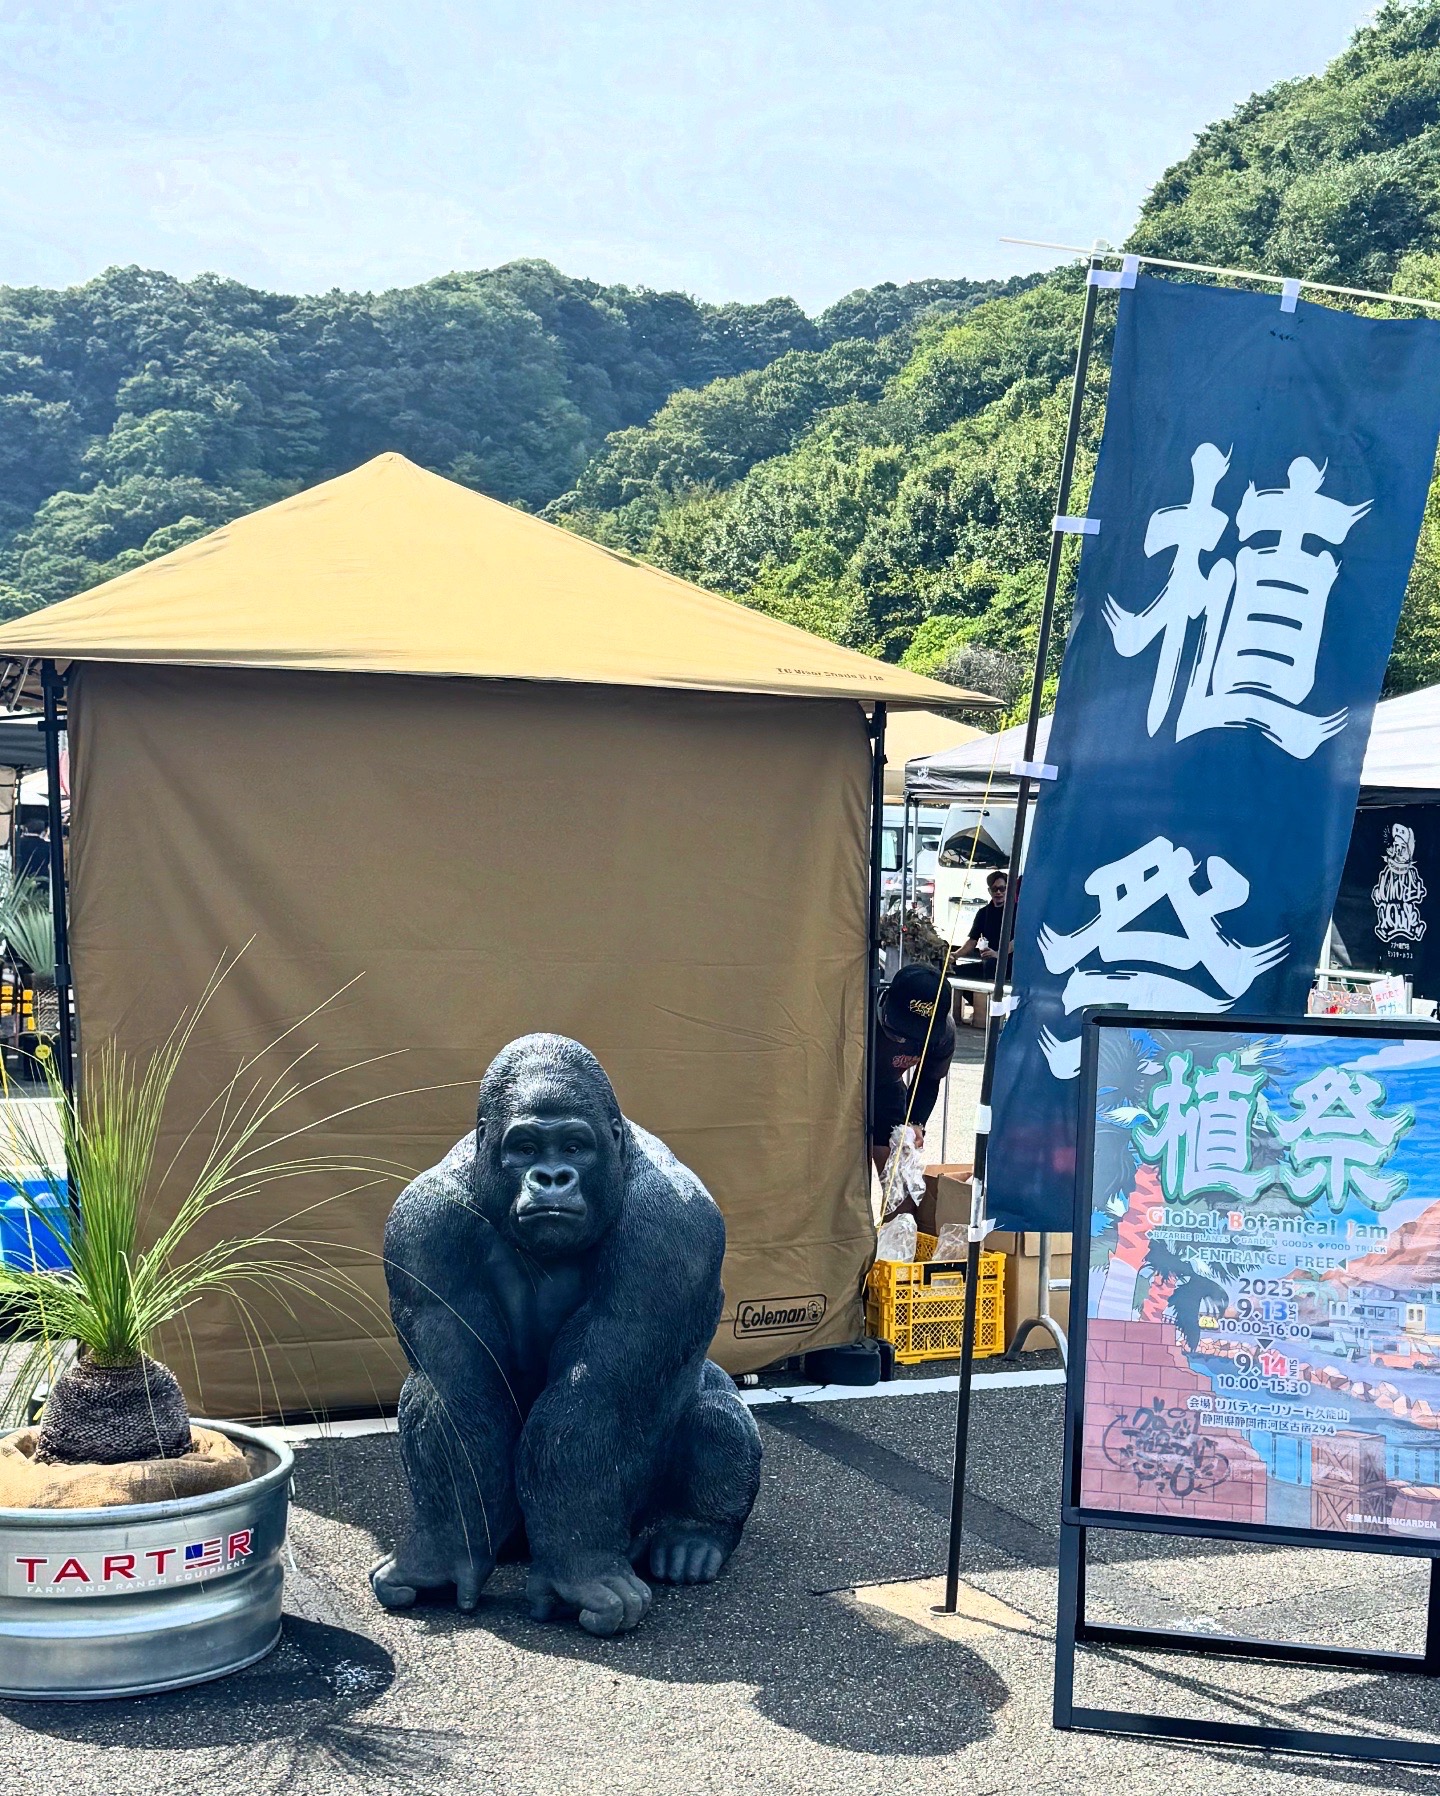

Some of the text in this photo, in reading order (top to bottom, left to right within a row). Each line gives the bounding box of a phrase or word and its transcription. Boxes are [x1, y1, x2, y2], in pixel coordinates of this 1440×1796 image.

[1133, 1050, 1416, 1213] 植祭
[1147, 1206, 1388, 1240] Global Botanical Jam
[1153, 1231, 1387, 1253] BIZARRE PLANTS GARDEN GOODS FOOD TRUCK
[1200, 1247, 1335, 1269] ENTRANCE FREE
[1238, 1277, 1294, 1297] 2025
[741, 1304, 807, 1329] Coleman
[1236, 1298, 1297, 1321] 9.13 SAT
[1219, 1320, 1310, 1338] 10:00-16:00
[1235, 1353, 1298, 1377] 9.14 SUN
[1218, 1375, 1309, 1394] 10:00-15:30
[1189, 1397, 1211, 1410] 会場
[1363, 1514, 1437, 1530] MALIBUGARDEN
[15, 1529, 253, 1585] TARTER
[26, 1558, 247, 1594] FARM AND RANCH EQUIPMENT
